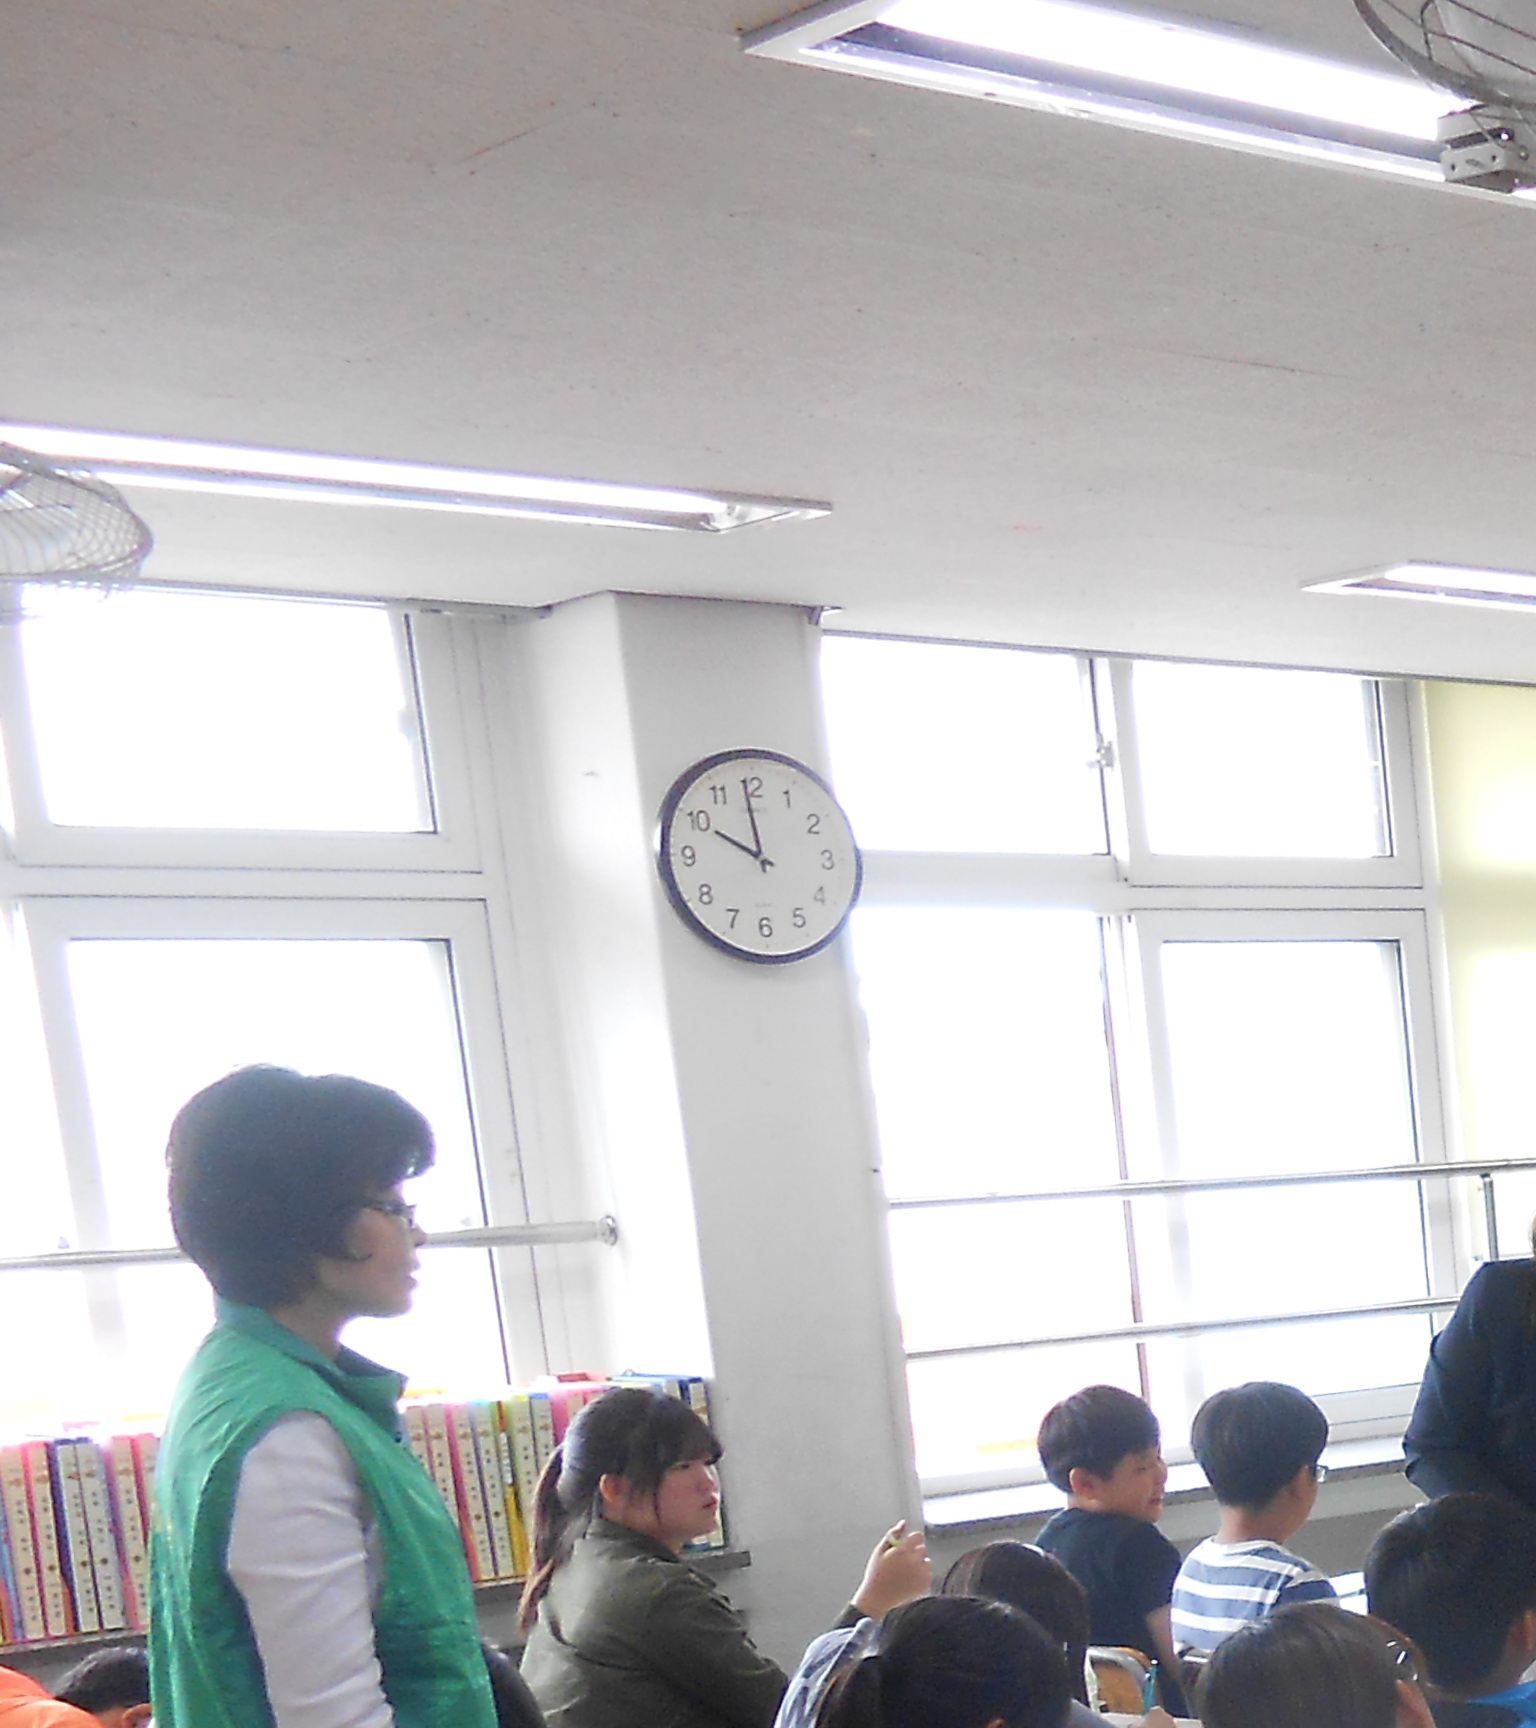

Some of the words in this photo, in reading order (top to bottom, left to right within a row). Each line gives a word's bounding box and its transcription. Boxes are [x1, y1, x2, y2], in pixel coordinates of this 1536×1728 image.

[709, 785, 728, 805] 11
[782, 789, 791, 808] 1
[687, 809, 711, 832] 10
[806, 813, 821, 835] 2
[680, 845, 696, 867] 9
[820, 849, 835, 870] 3
[698, 883, 714, 905] 8
[813, 886, 826, 905] 4
[726, 908, 740, 929] 7
[758, 916, 773, 938] 6
[792, 907, 807, 928] 5
